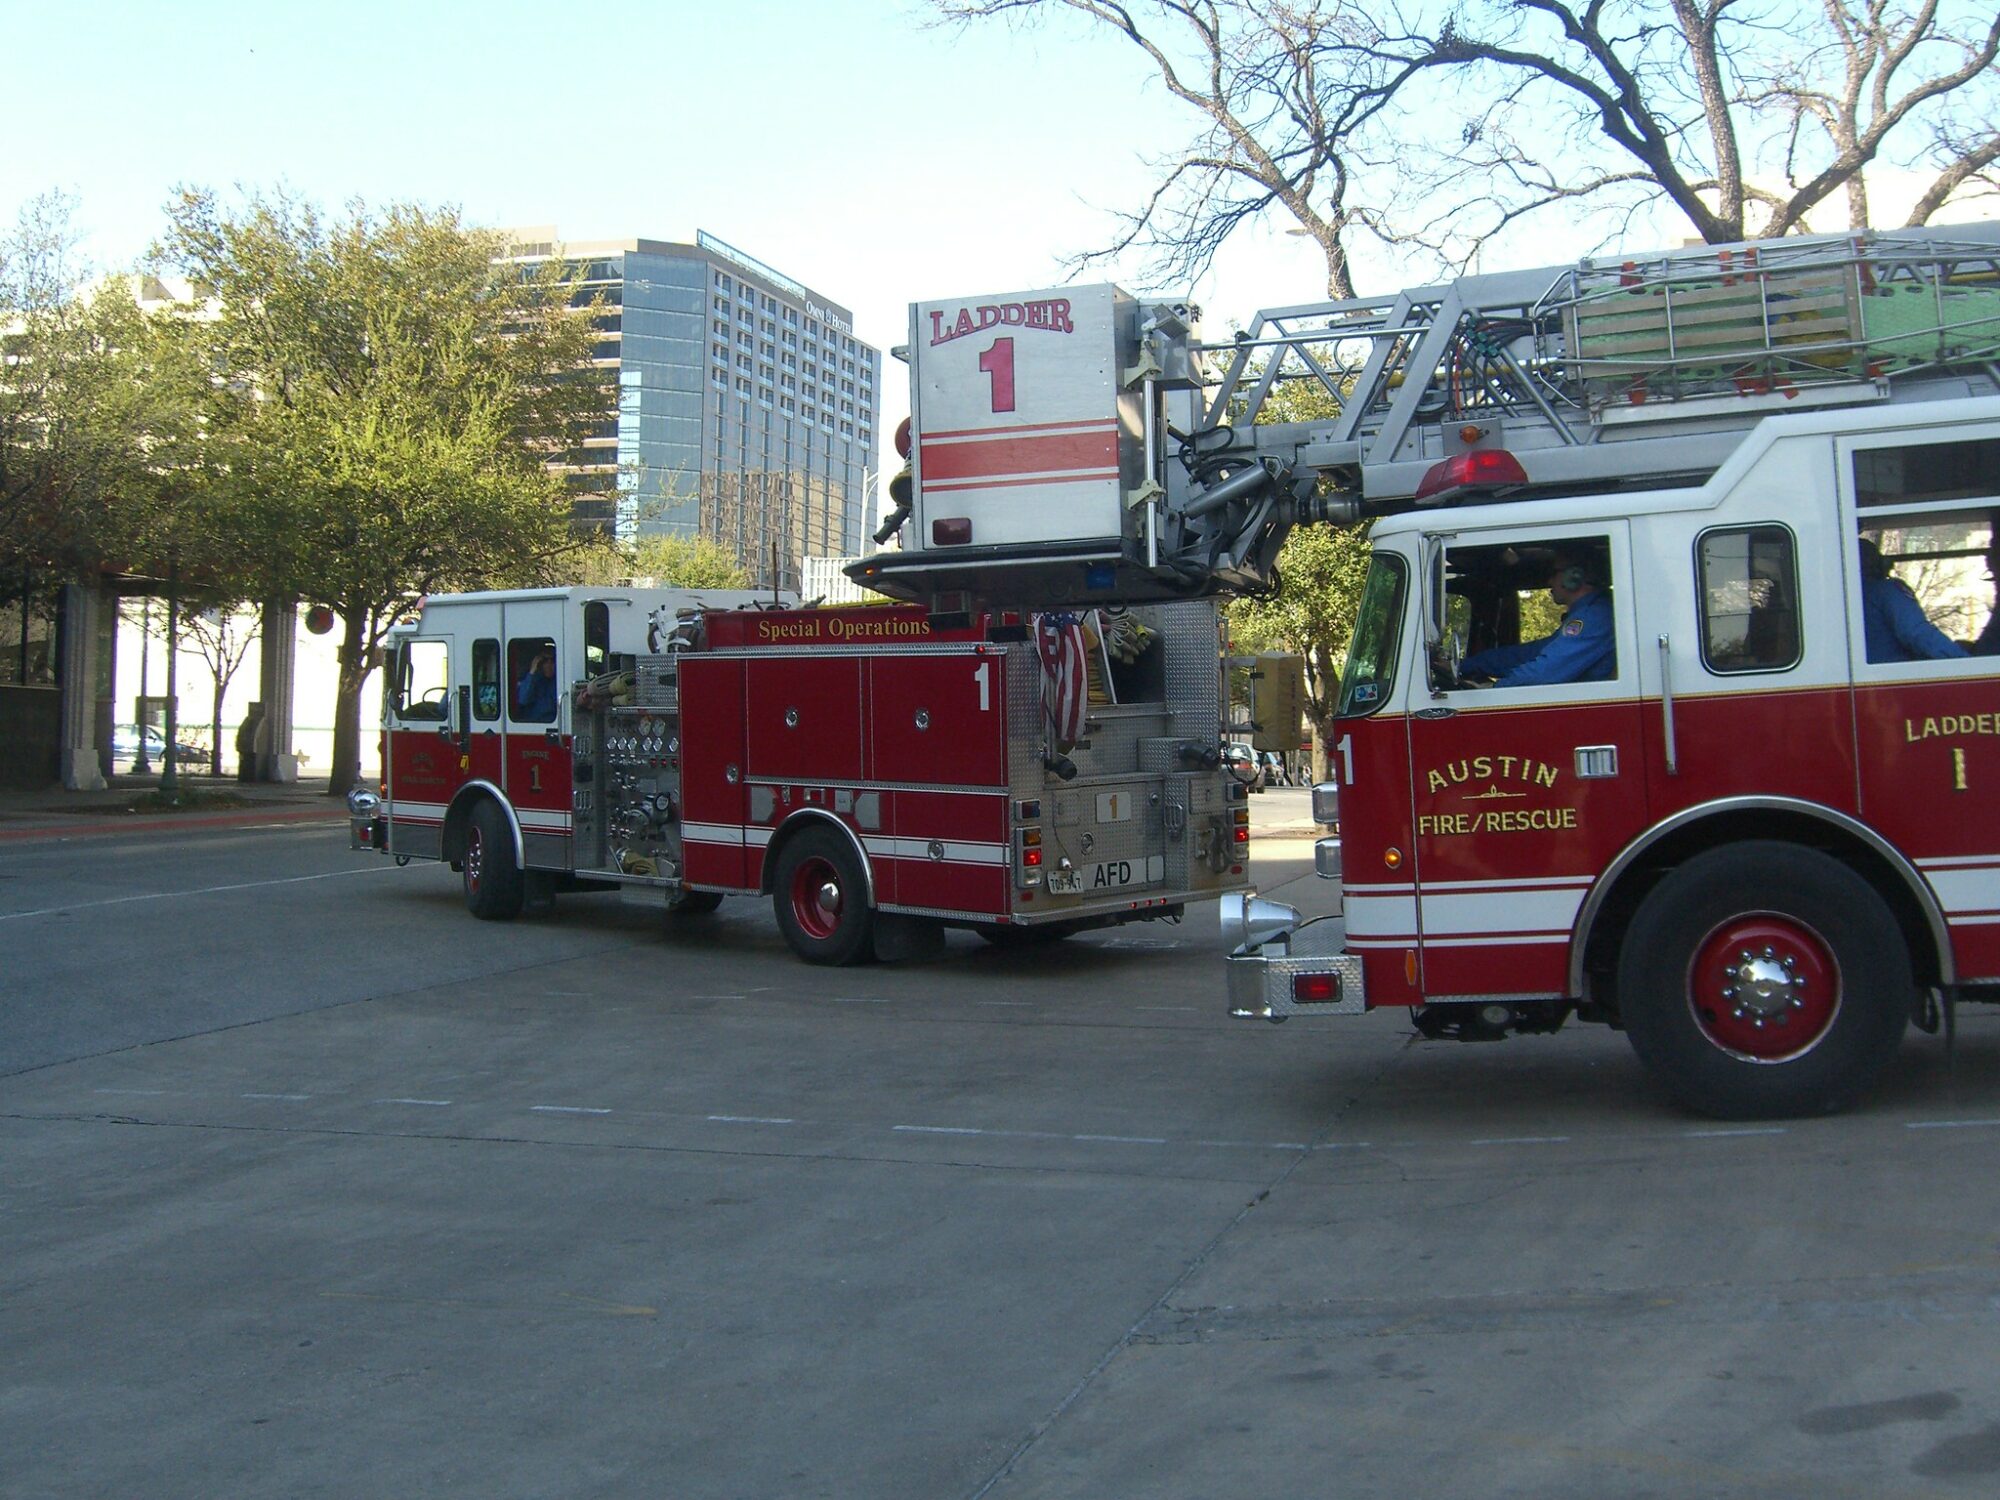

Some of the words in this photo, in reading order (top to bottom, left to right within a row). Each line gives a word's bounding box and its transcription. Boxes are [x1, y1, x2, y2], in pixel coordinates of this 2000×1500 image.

[930, 298, 1074, 347] LADDER
[979, 336, 1015, 413] 1
[759, 619, 820, 641] Special
[828, 616, 930, 640] Operations
[974, 662, 990, 711] 1
[530, 764, 542, 790] 1
[1337, 734, 1354, 785] 1
[1426, 755, 1559, 794] AUSTIN
[1952, 748, 1968, 790] 1
[1109, 794, 1118, 819] 1
[1418, 808, 1577, 836] FIRE/RESCUE
[1093, 861, 1131, 888] AFD
